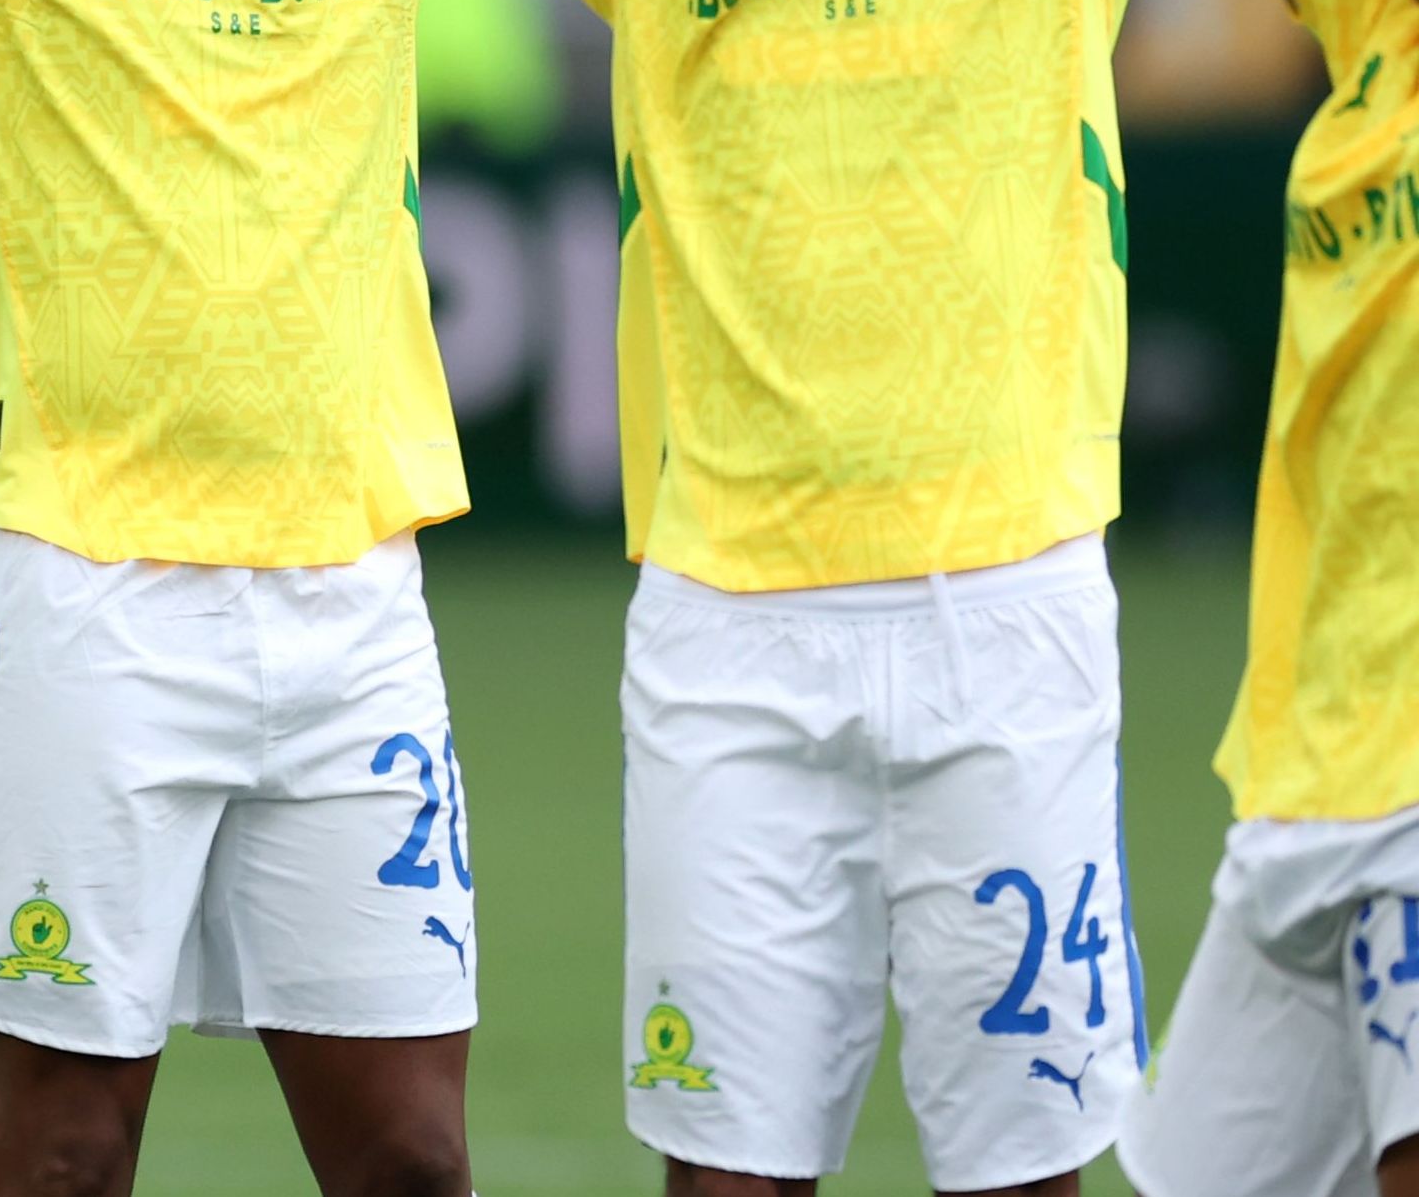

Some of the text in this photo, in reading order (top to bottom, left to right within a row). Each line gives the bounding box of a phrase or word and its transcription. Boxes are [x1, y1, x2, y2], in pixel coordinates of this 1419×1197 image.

[825, 0, 836, 21] S
[211, 12, 261, 35] S & E
[974, 863, 1108, 1035] 24
